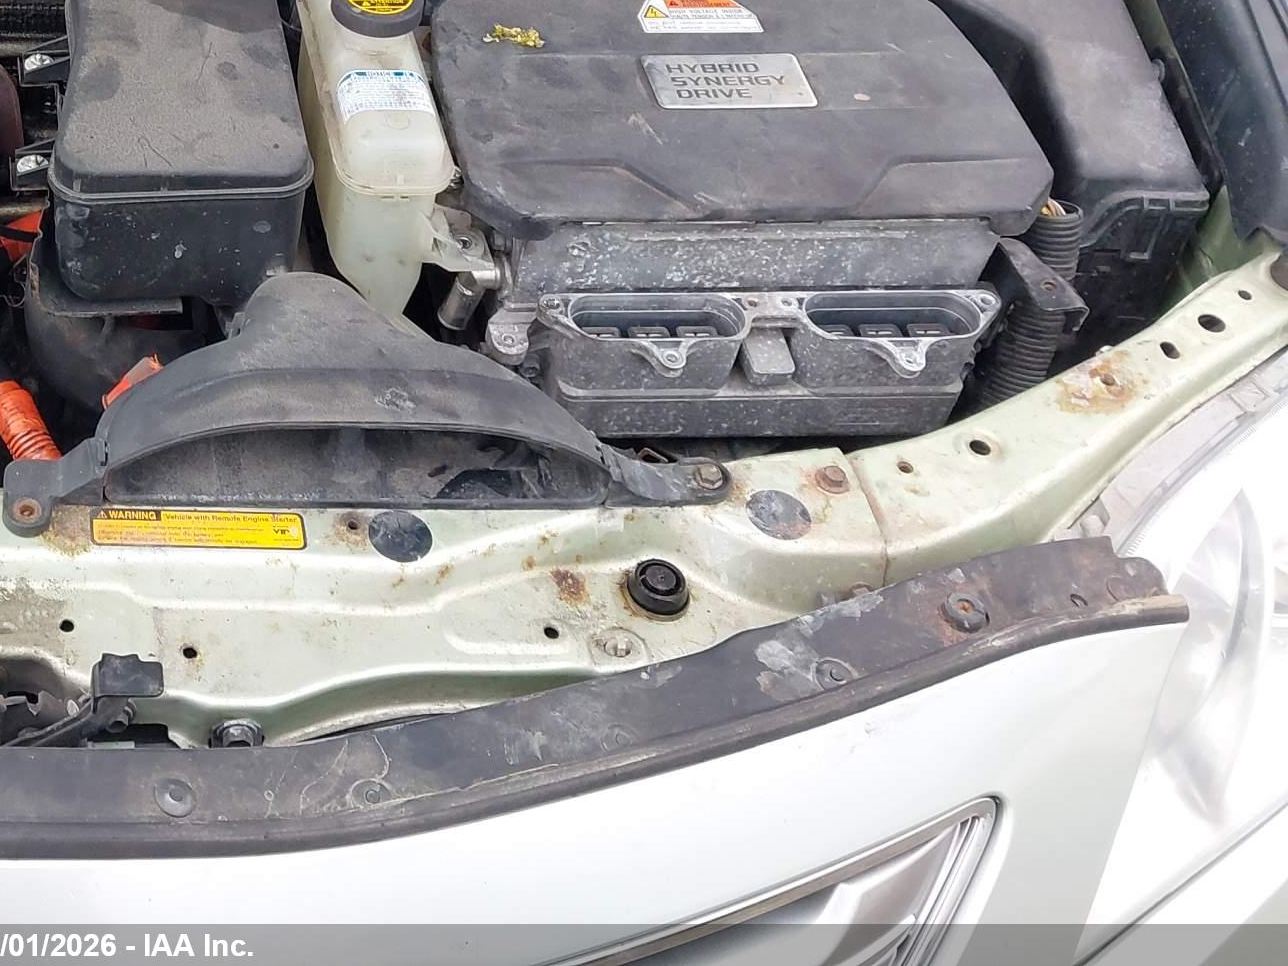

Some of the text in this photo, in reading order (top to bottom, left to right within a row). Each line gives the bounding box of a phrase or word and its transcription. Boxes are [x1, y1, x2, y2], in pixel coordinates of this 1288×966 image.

[665, 63, 760, 74] HYBRID
[671, 75, 785, 87] SYNERGY
[677, 88, 753, 99] DRIVE
[108, 510, 157, 520] WARNING
[243, 515, 269, 523] Engine
